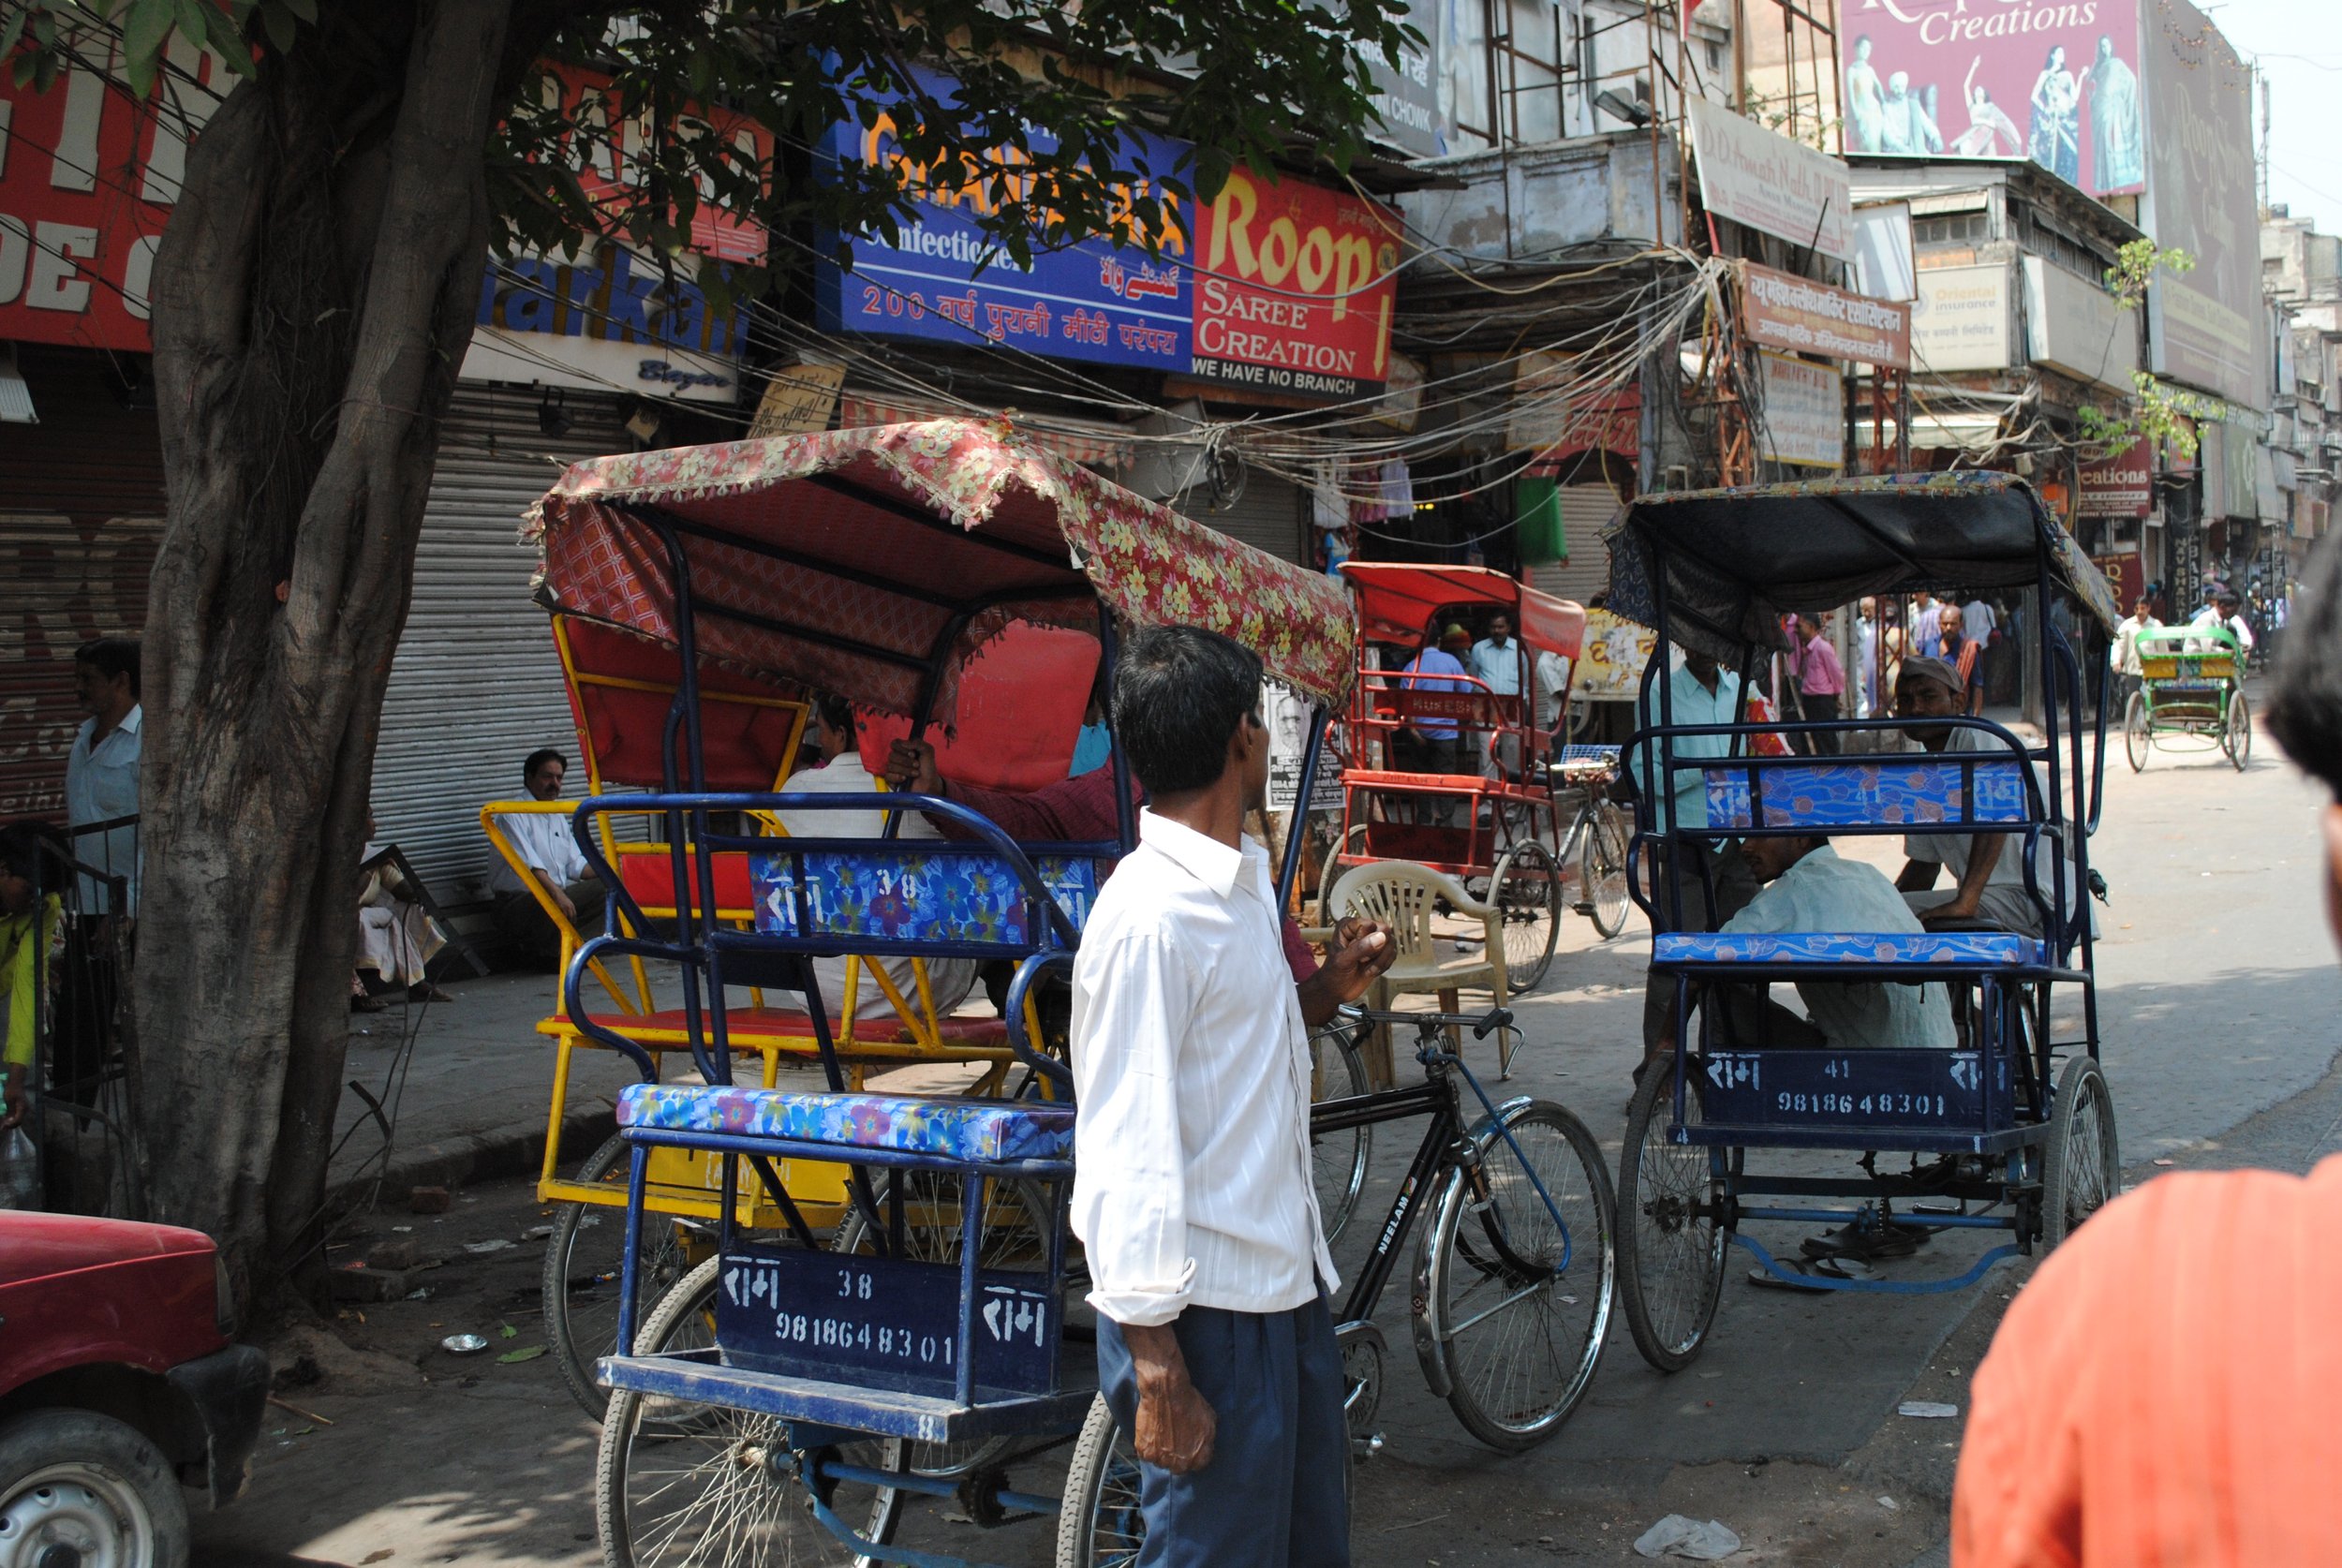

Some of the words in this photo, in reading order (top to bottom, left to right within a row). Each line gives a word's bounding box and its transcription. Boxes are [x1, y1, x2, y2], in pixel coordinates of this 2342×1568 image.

[1920, 2, 2097, 45] Creations
[1392, 97, 1431, 133] CHOWK
[1208, 173, 1373, 322] Roop
[1935, 285, 1996, 301] Oriental
[1935, 300, 1996, 312] insurance
[862, 286, 926, 319] 200
[937, 289, 978, 330] वर्ष
[986, 302, 1052, 343] पुरानी
[1119, 319, 1178, 356] परंपरा
[1198, 317, 1356, 373] CREATION
[1192, 356, 1218, 377] WE
[1222, 361, 1265, 383] HAVE
[1267, 369, 1291, 387] NO
[1294, 371, 1356, 395] BRANCH
[2080, 466, 2148, 485] eations
[877, 869, 916, 900] 38
[1707, 1052, 1762, 1091] राम
[1825, 1059, 1850, 1078] 41
[1778, 1091, 1945, 1117] 9818648301
[1377, 1195, 1410, 1256] NEELAM
[724, 1256, 781, 1310] राम
[837, 1270, 873, 1300] 38
[984, 1285, 1048, 1348] राम
[775, 1312, 953, 1366] 9818648301
